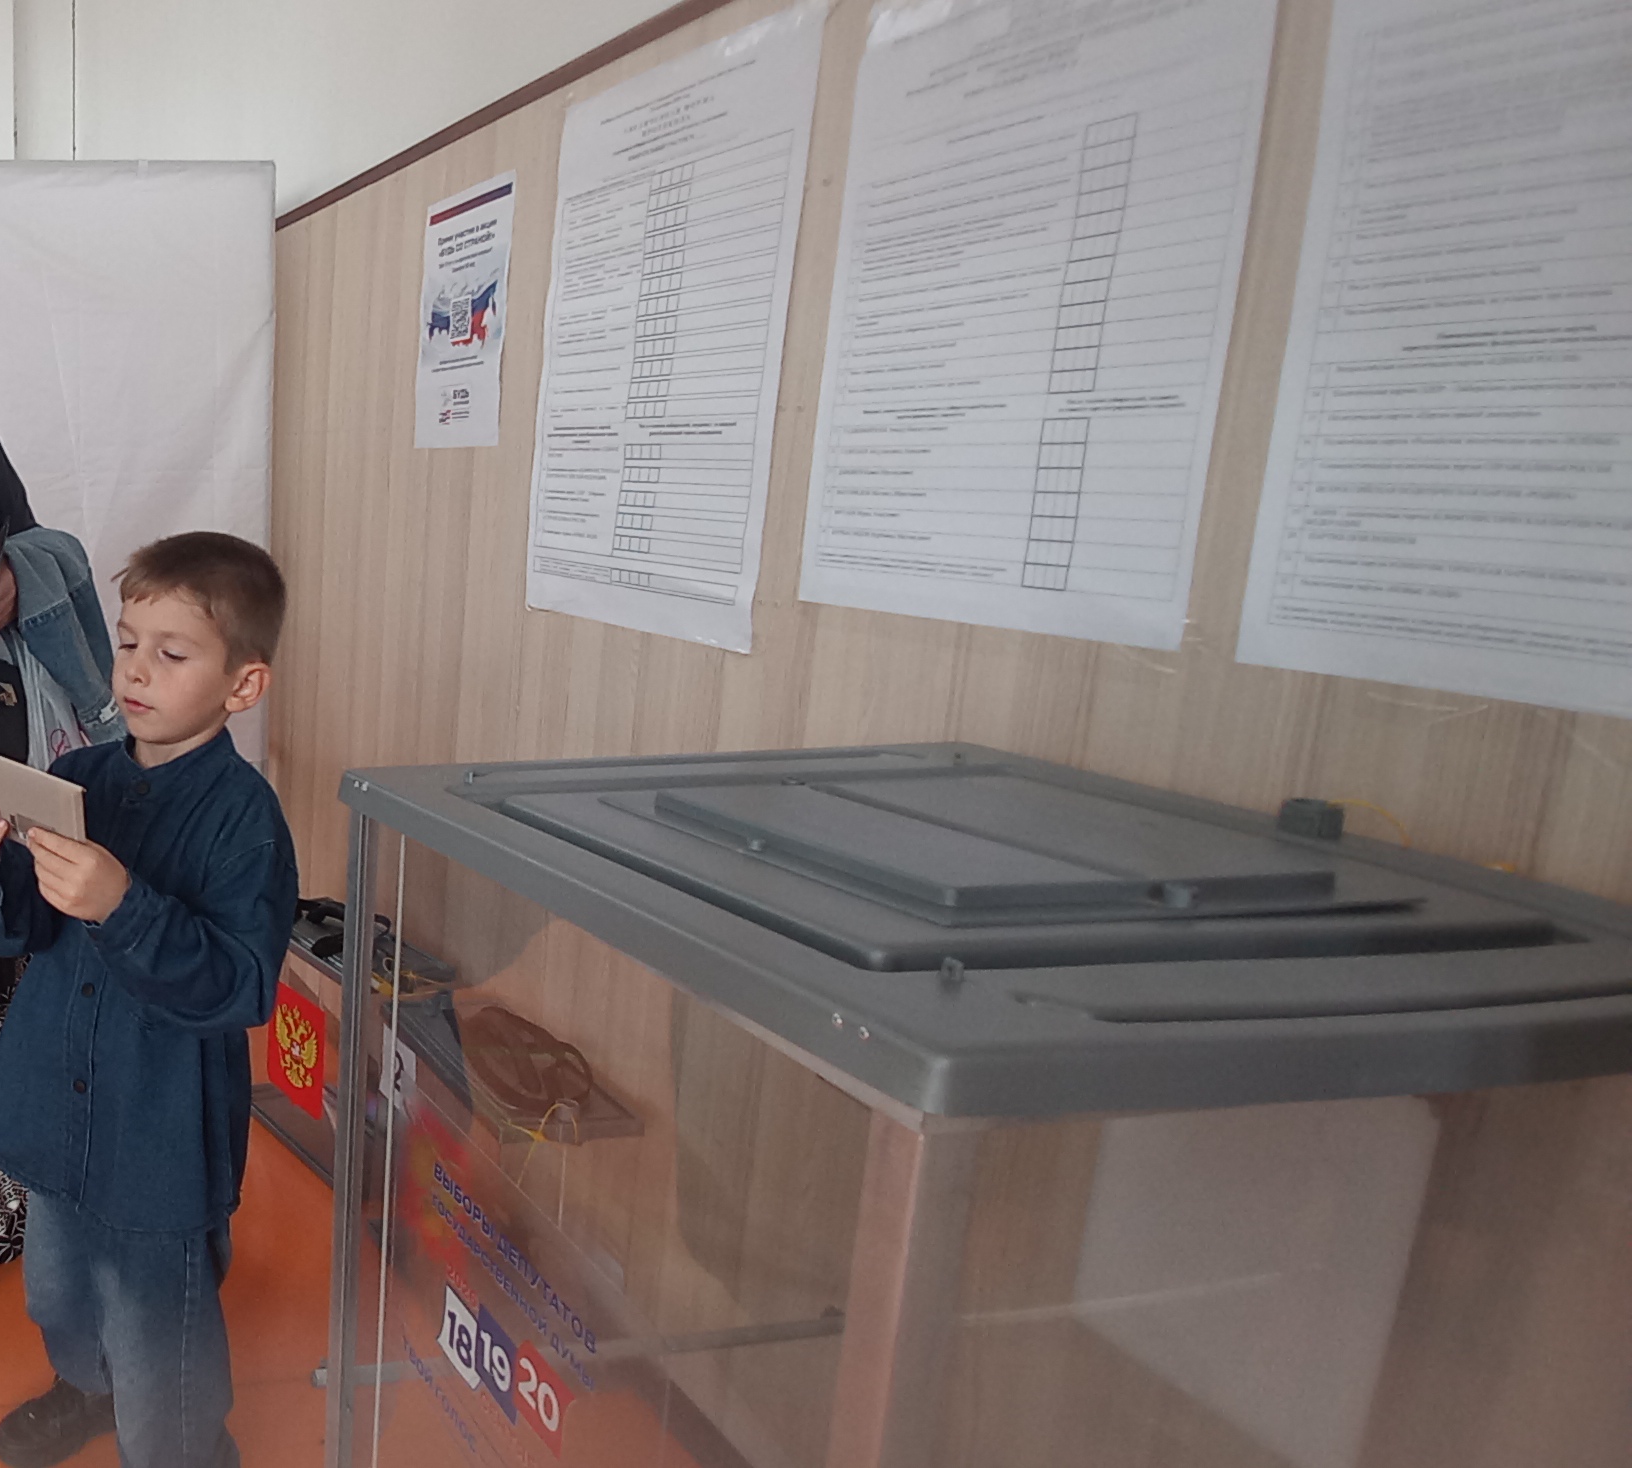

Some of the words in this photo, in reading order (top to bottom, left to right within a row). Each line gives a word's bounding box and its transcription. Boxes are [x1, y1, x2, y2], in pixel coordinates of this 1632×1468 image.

[432, 1193, 547, 1336] ГОСУДАРСТВЕННОЙ
[433, 1161, 496, 1239] ВЫБОРЫ
[497, 1232, 597, 1354] ДЕПУТАТОВ
[448, 1310, 472, 1369] 18
[480, 1329, 511, 1392] 19
[518, 1357, 559, 1432] 20
